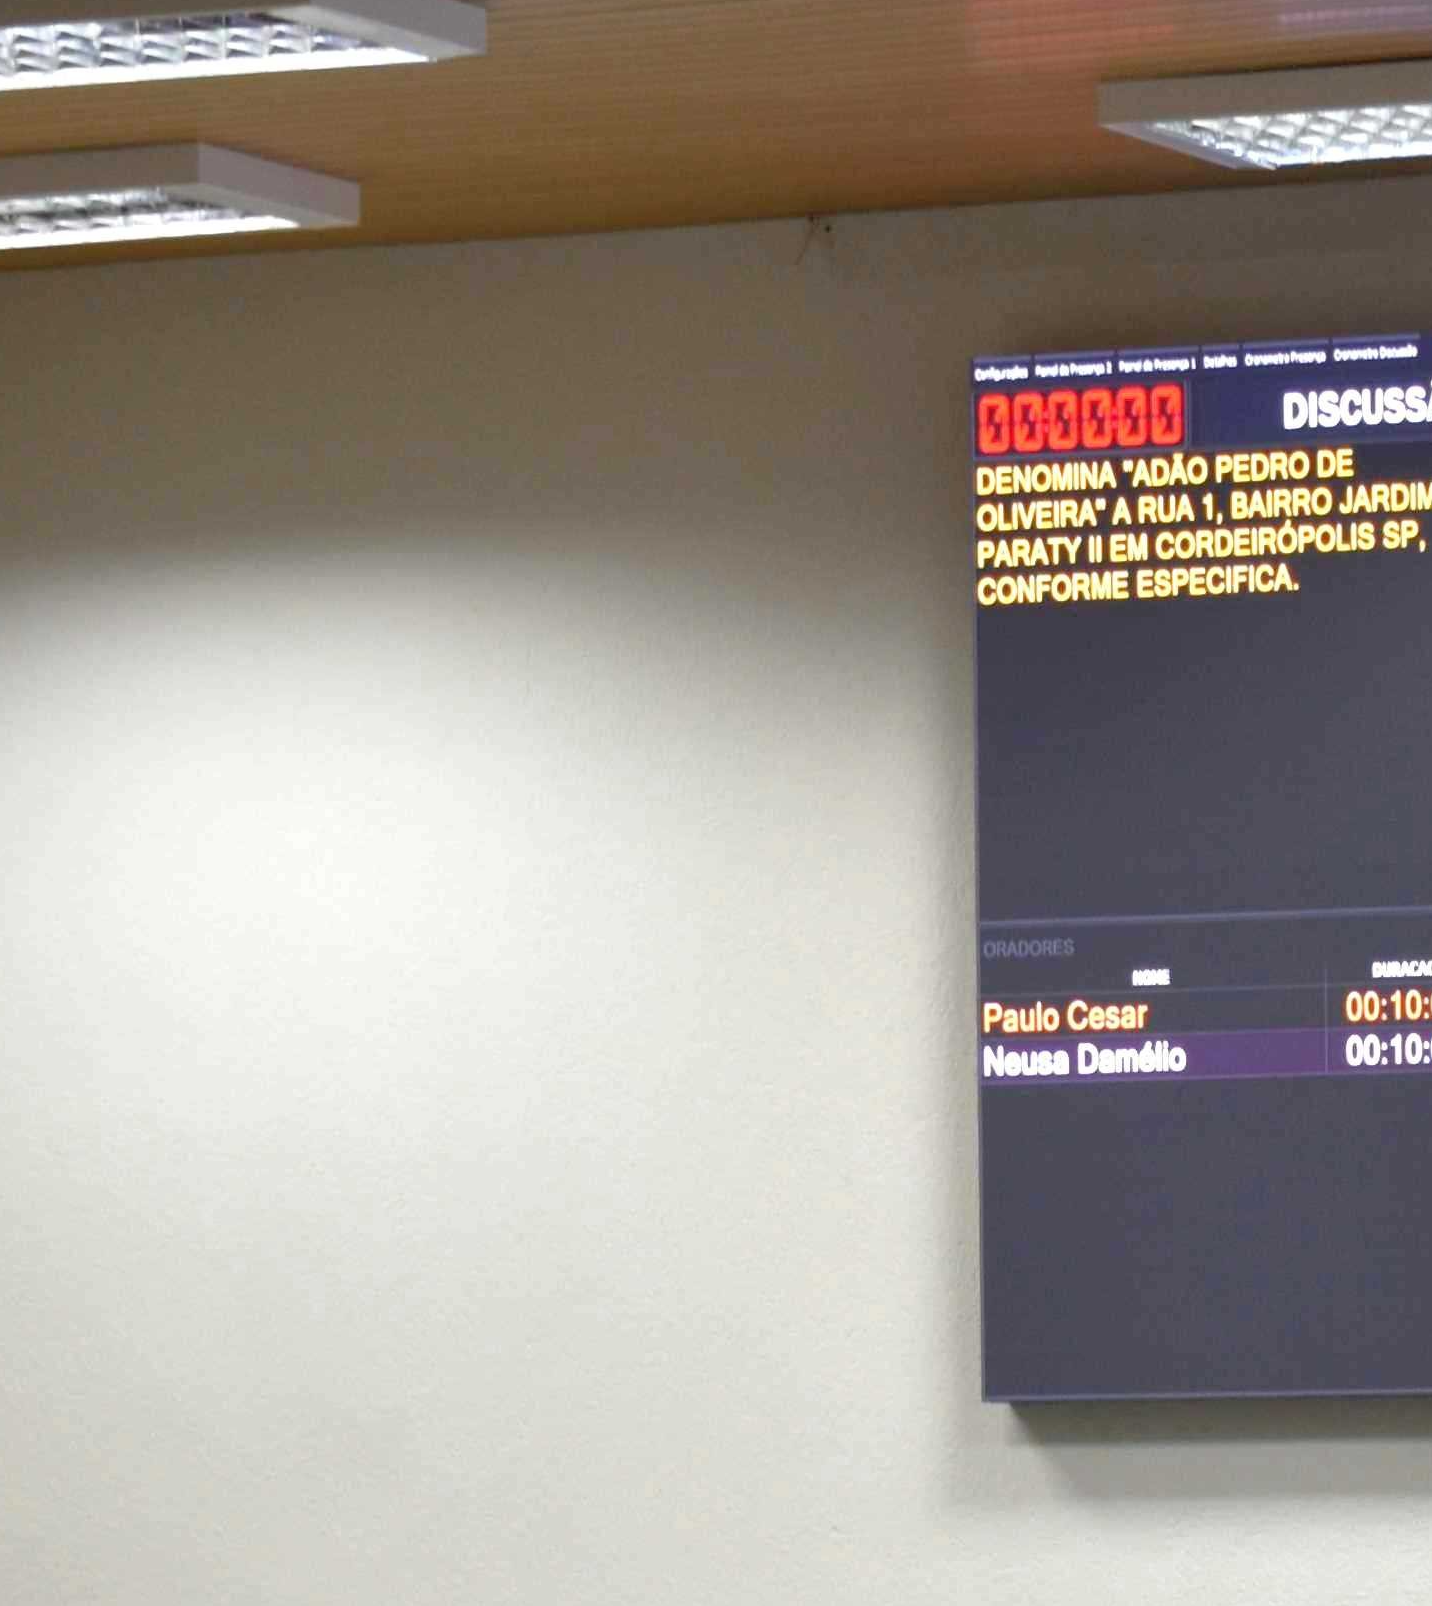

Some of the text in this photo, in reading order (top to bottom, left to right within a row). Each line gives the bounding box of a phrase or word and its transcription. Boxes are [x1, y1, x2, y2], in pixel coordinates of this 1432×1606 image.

[976, 448, 1354, 496] DENOMINA "ADÃO PEDRO DE
[976, 498, 1107, 532] OLIVEIRA"
[1112, 496, 1132, 526] A
[1138, 493, 1195, 524] RUA
[1202, 492, 1223, 525] 1,
[1230, 486, 1333, 520] BAIRRO
[977, 519, 1426, 569] PARATY II EM CORDEIRÓPOLIS SP,
[977, 563, 1300, 606] CONFORME ESPECIFICA.
[983, 937, 1075, 958] ORADORES
[1132, 968, 1171, 986] NOME
[983, 999, 1148, 1033] Paulo Cesar
[983, 1041, 1187, 1078] Neusa Damélio
